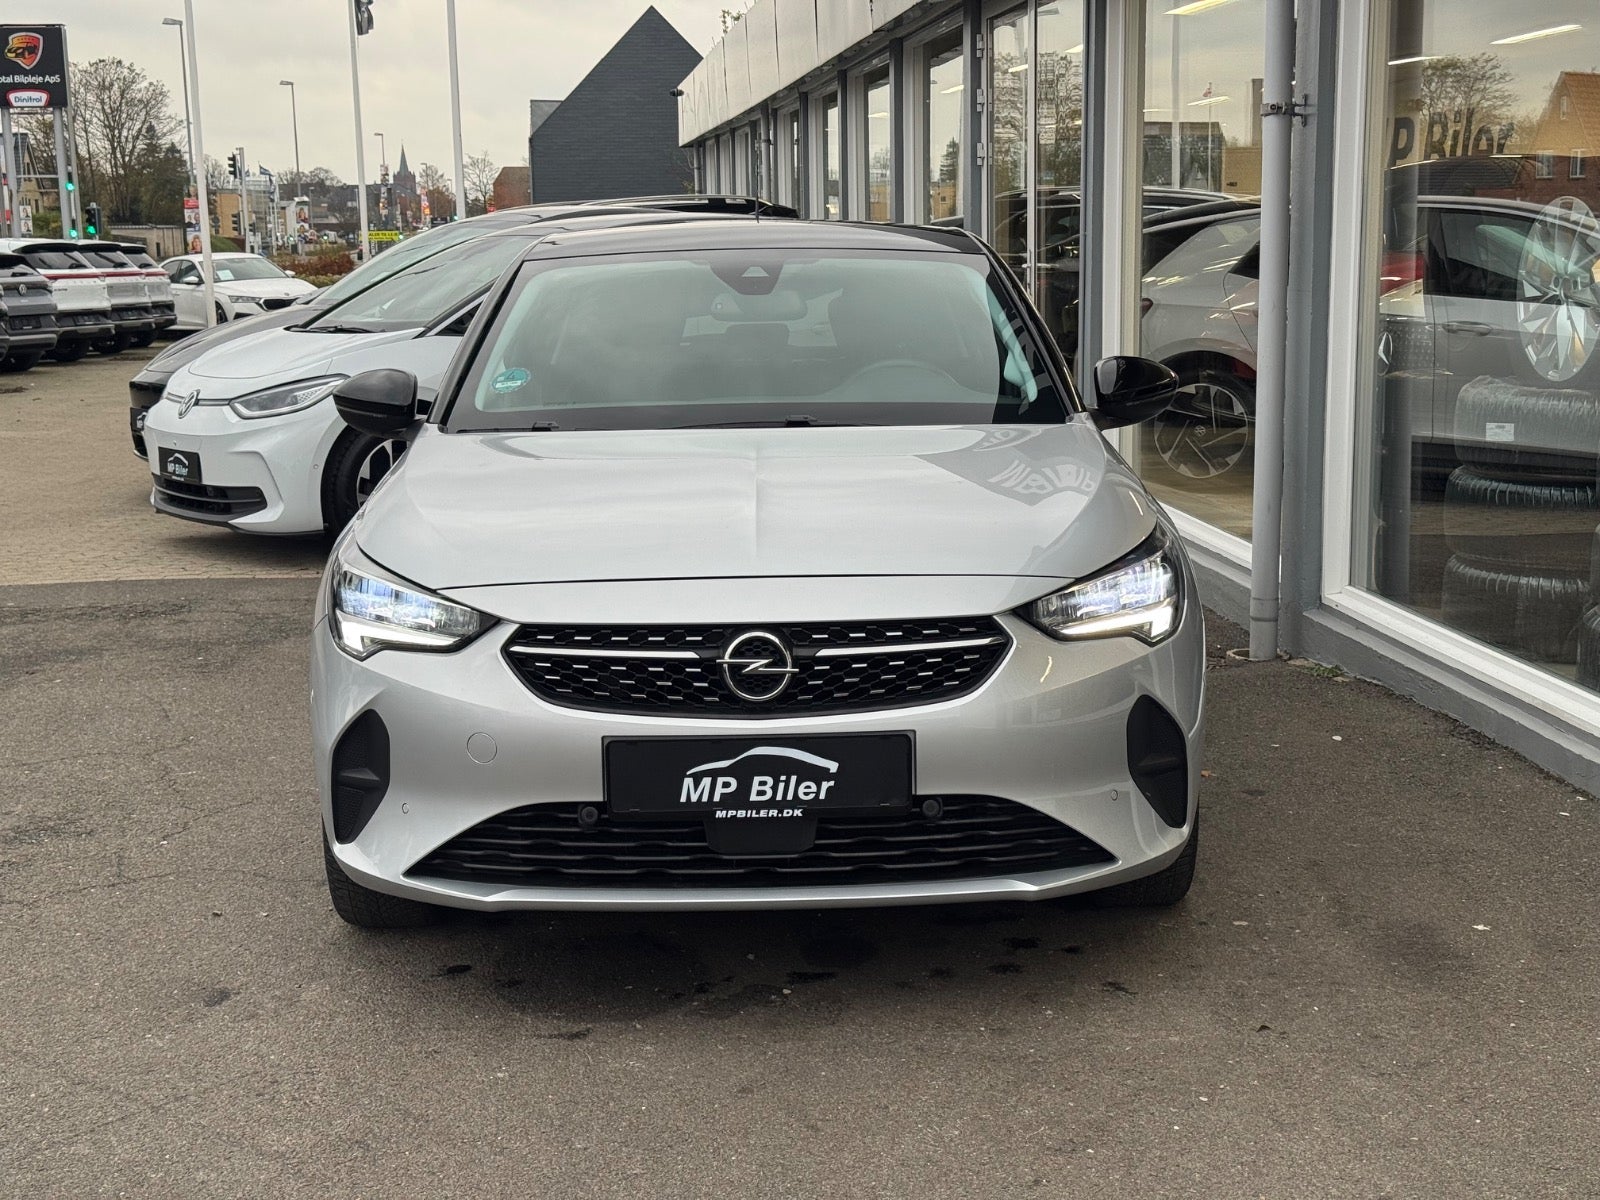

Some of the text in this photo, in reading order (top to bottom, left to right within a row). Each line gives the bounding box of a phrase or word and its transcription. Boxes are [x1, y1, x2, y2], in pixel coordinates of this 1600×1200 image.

[0, 75, 61, 84] otal Bilpleje ApS
[1386, 116, 1415, 169] P
[679, 775, 835, 803] MP Biler
[715, 808, 804, 819] MPBILER.DK
